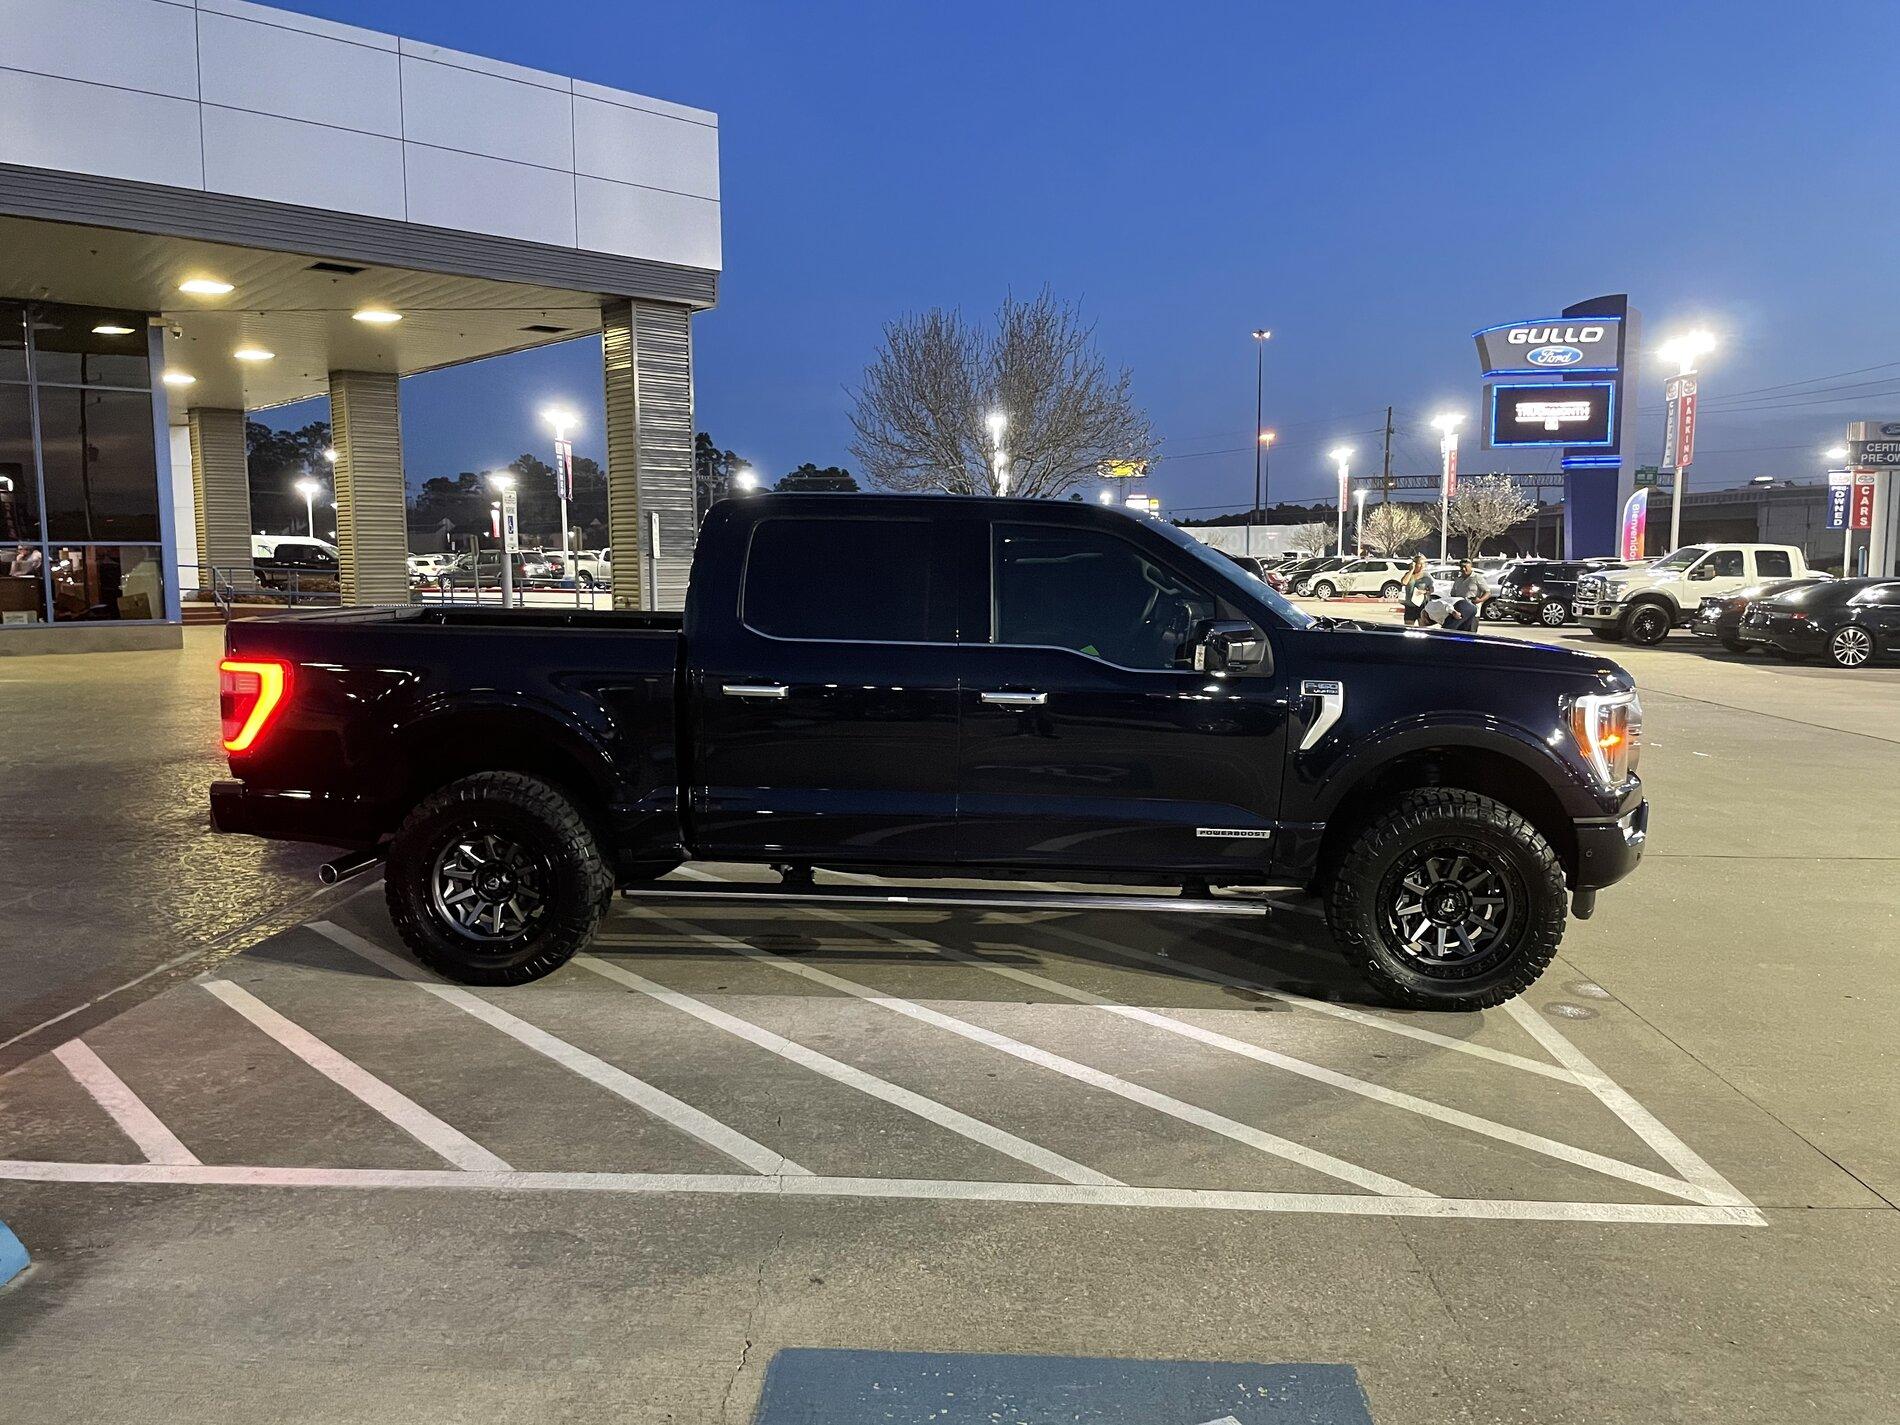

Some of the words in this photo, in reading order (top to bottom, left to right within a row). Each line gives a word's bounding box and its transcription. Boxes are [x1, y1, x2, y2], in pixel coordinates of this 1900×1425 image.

[1507, 327, 1604, 344] GULLO
[1537, 349, 1572, 363] Ford
[1682, 397, 1693, 463] PARKING
[1866, 443, 1900, 452] CERTI
[1833, 491, 1845, 526] OWNED
[1860, 486, 1870, 526] CARS
